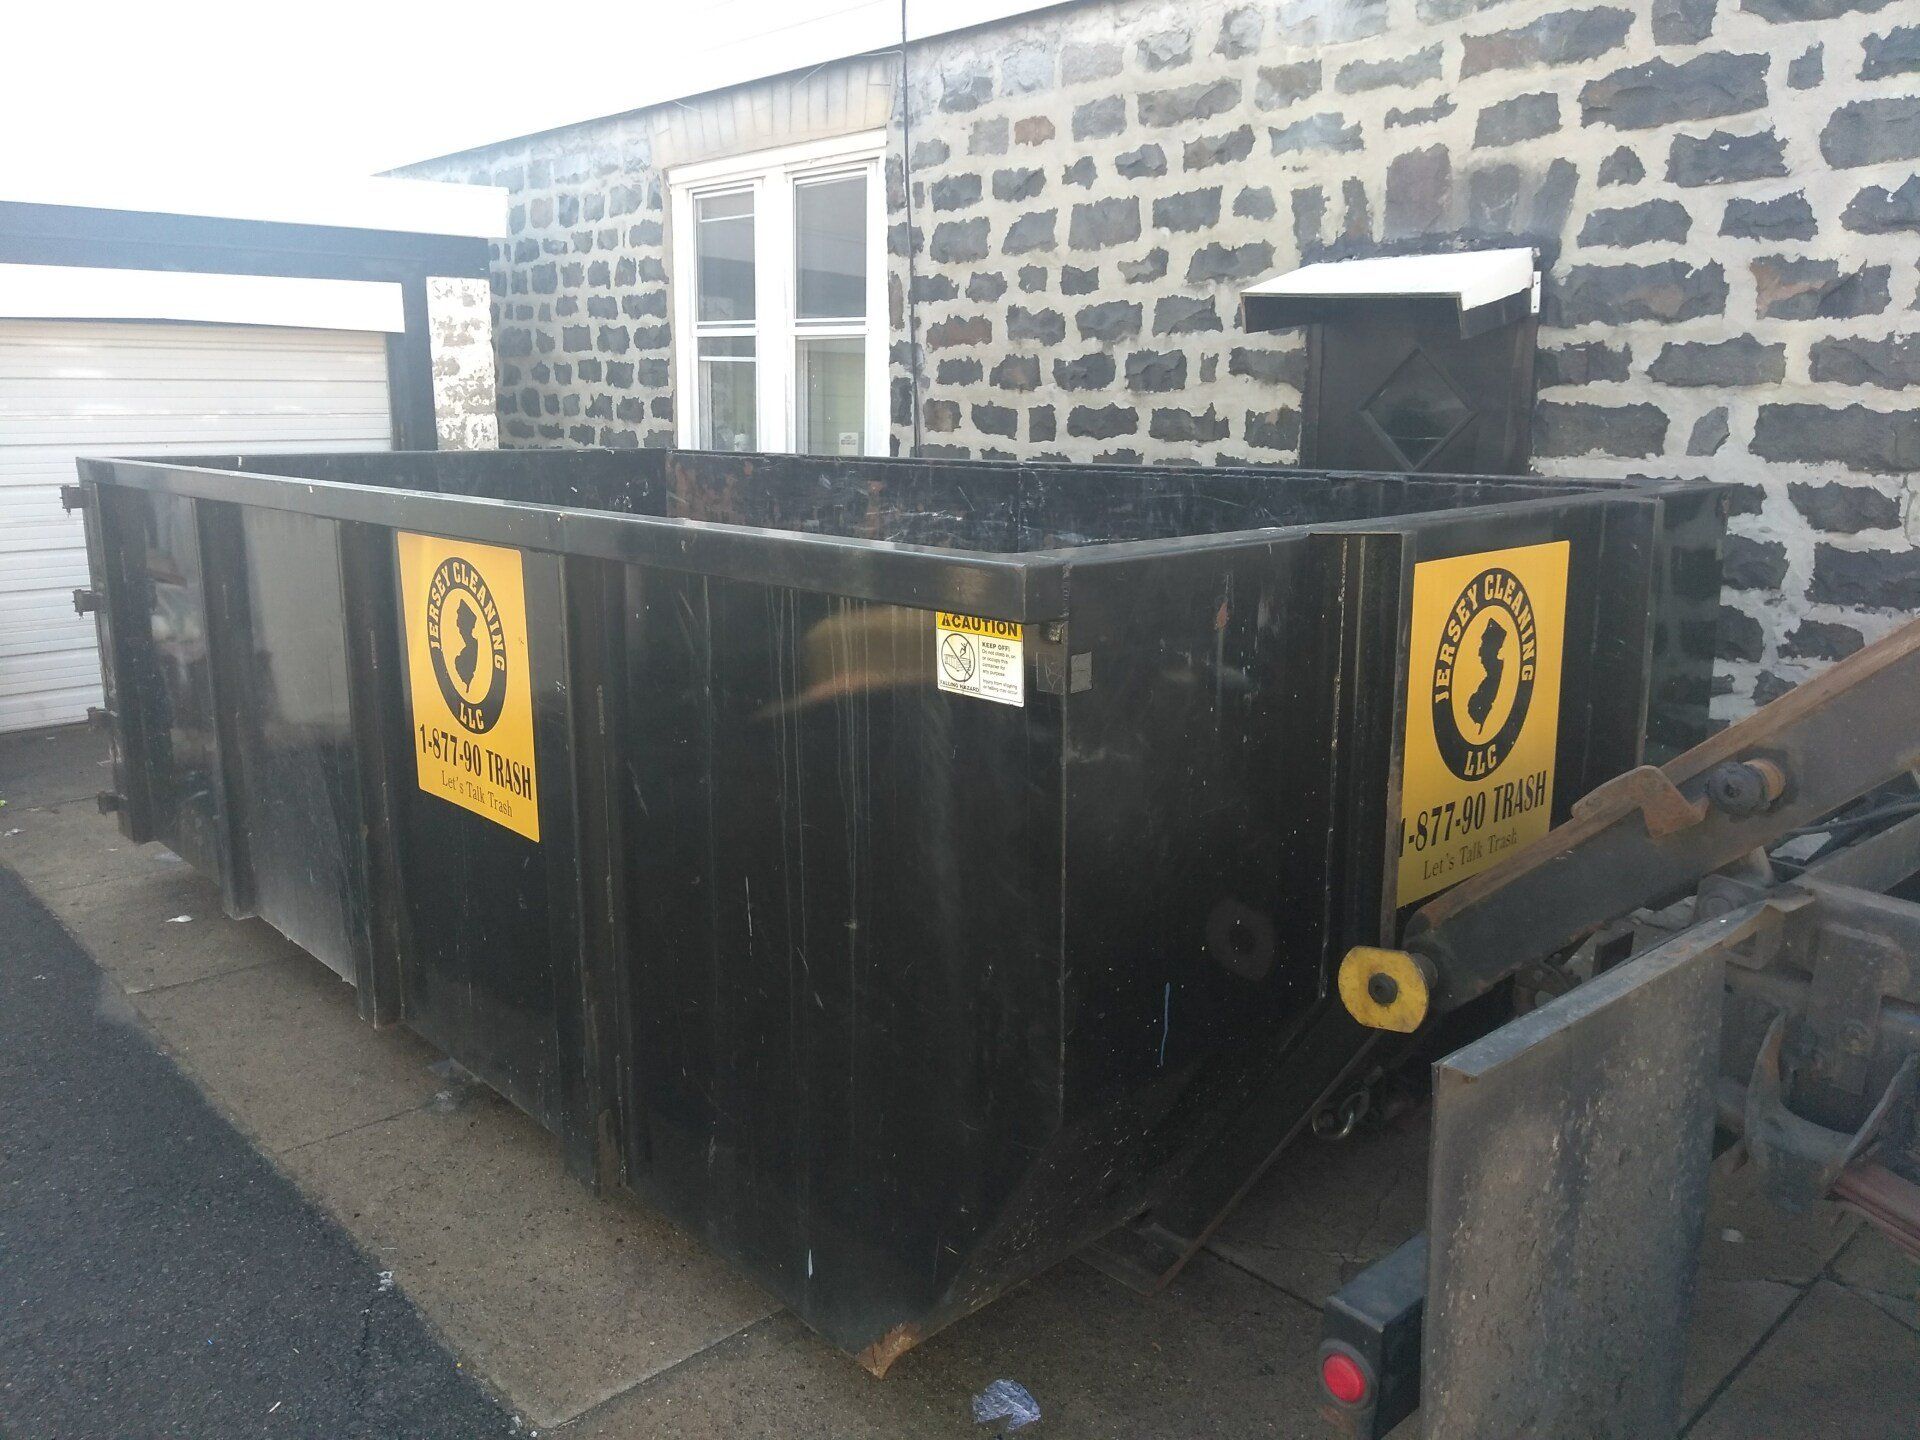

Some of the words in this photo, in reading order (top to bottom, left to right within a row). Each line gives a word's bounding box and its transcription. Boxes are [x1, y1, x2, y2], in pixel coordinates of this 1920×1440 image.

[428, 565, 451, 649] JERSEY
[453, 561, 505, 671] CLEANING
[952, 614, 1018, 637] CAUTION
[1435, 584, 1478, 703] JERSEY
[1484, 574, 1535, 681] CLEANING
[960, 684, 979, 692] HAZARD
[460, 703, 485, 729] LLC
[420, 723, 482, 776] 1-877-90
[485, 749, 532, 800] TRASH
[1464, 744, 1497, 775] LLC
[441, 770, 463, 794] Let's
[466, 781, 485, 804] Talk
[488, 791, 513, 817] Trash
[1493, 771, 1547, 823] TRASH
[1424, 853, 1454, 880] Let's
[1459, 841, 1483, 866] Talk
[1488, 828, 1518, 854] Trash
